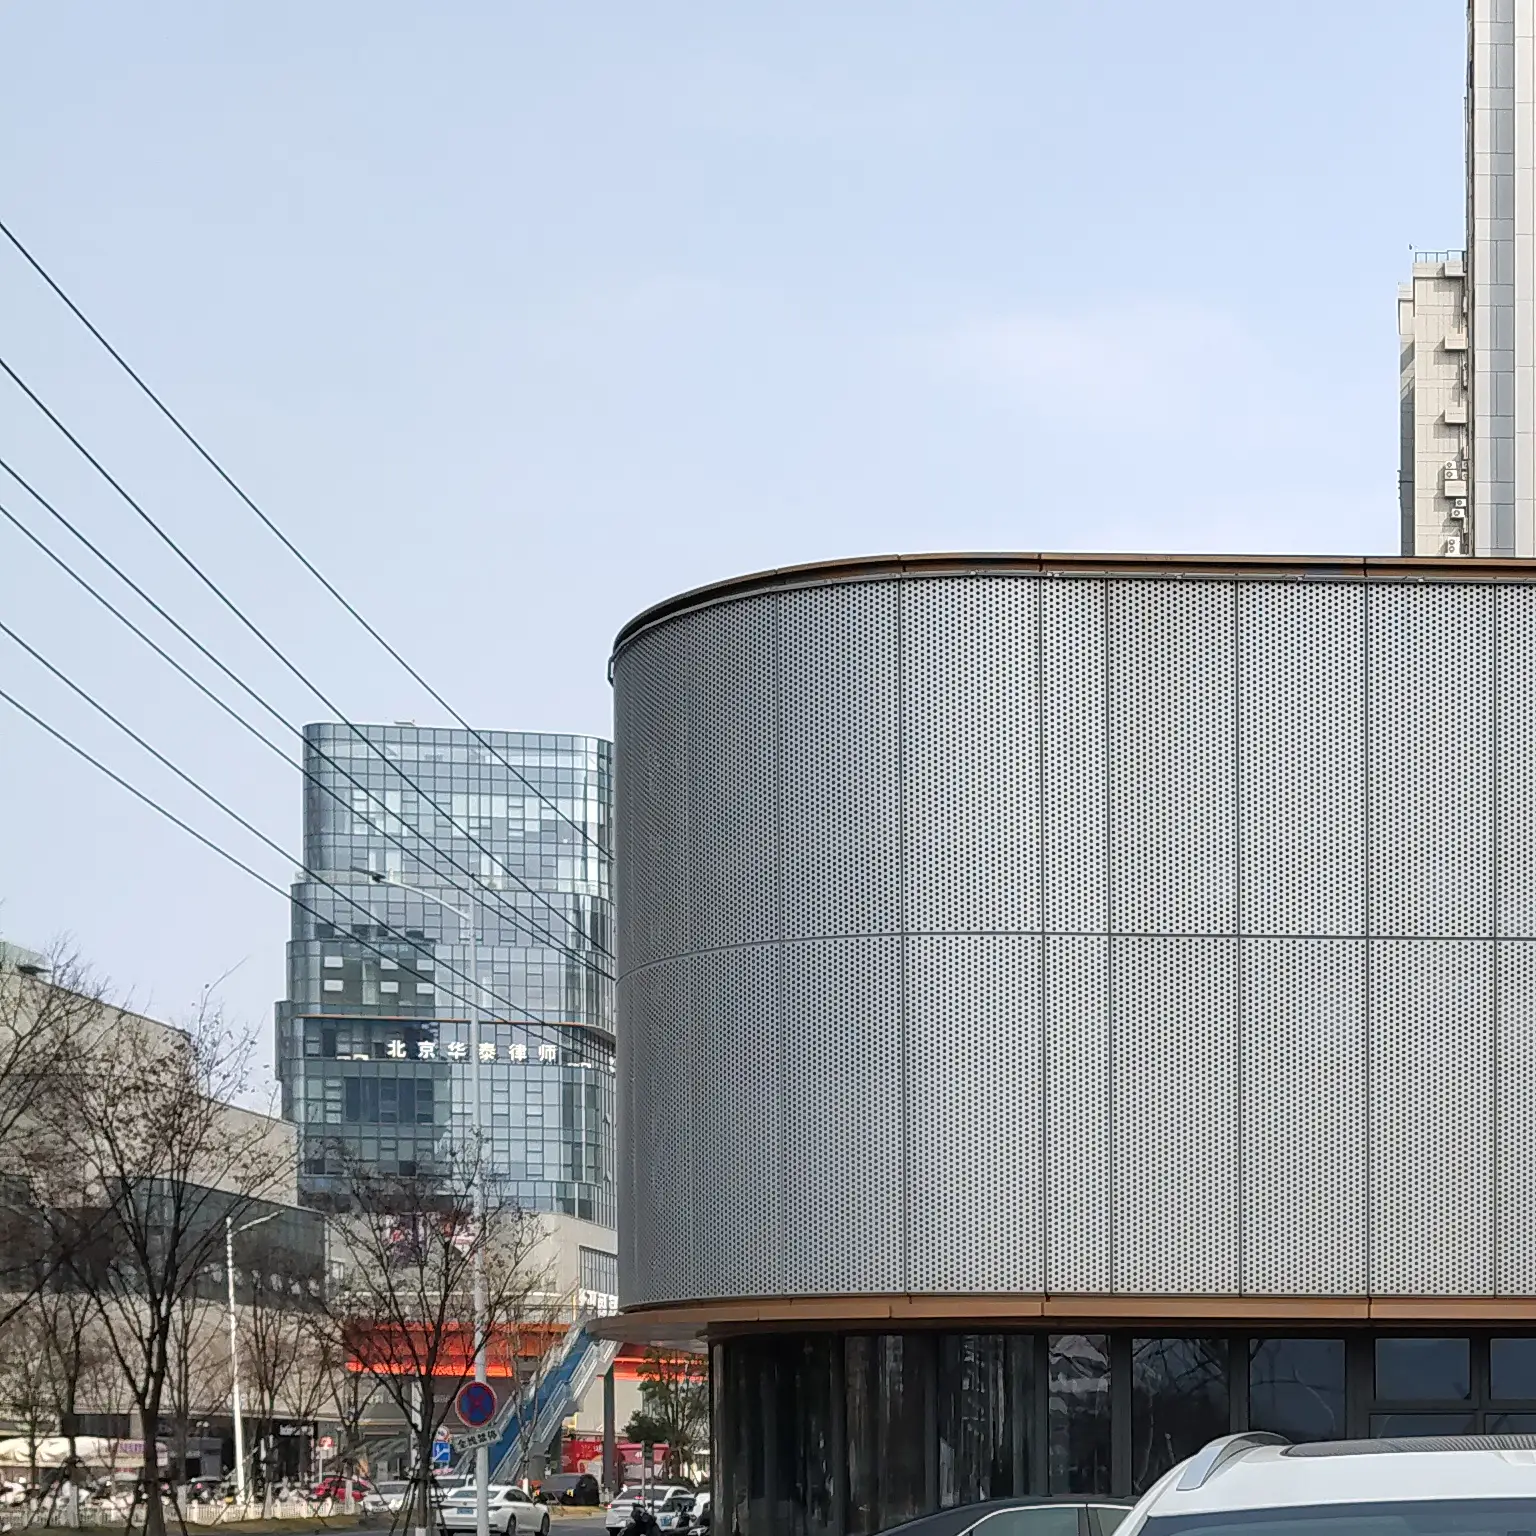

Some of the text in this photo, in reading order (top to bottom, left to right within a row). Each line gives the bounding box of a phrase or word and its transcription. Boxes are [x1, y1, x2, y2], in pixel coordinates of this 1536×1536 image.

[387, 1039, 560, 1063] 北京华泰律师
